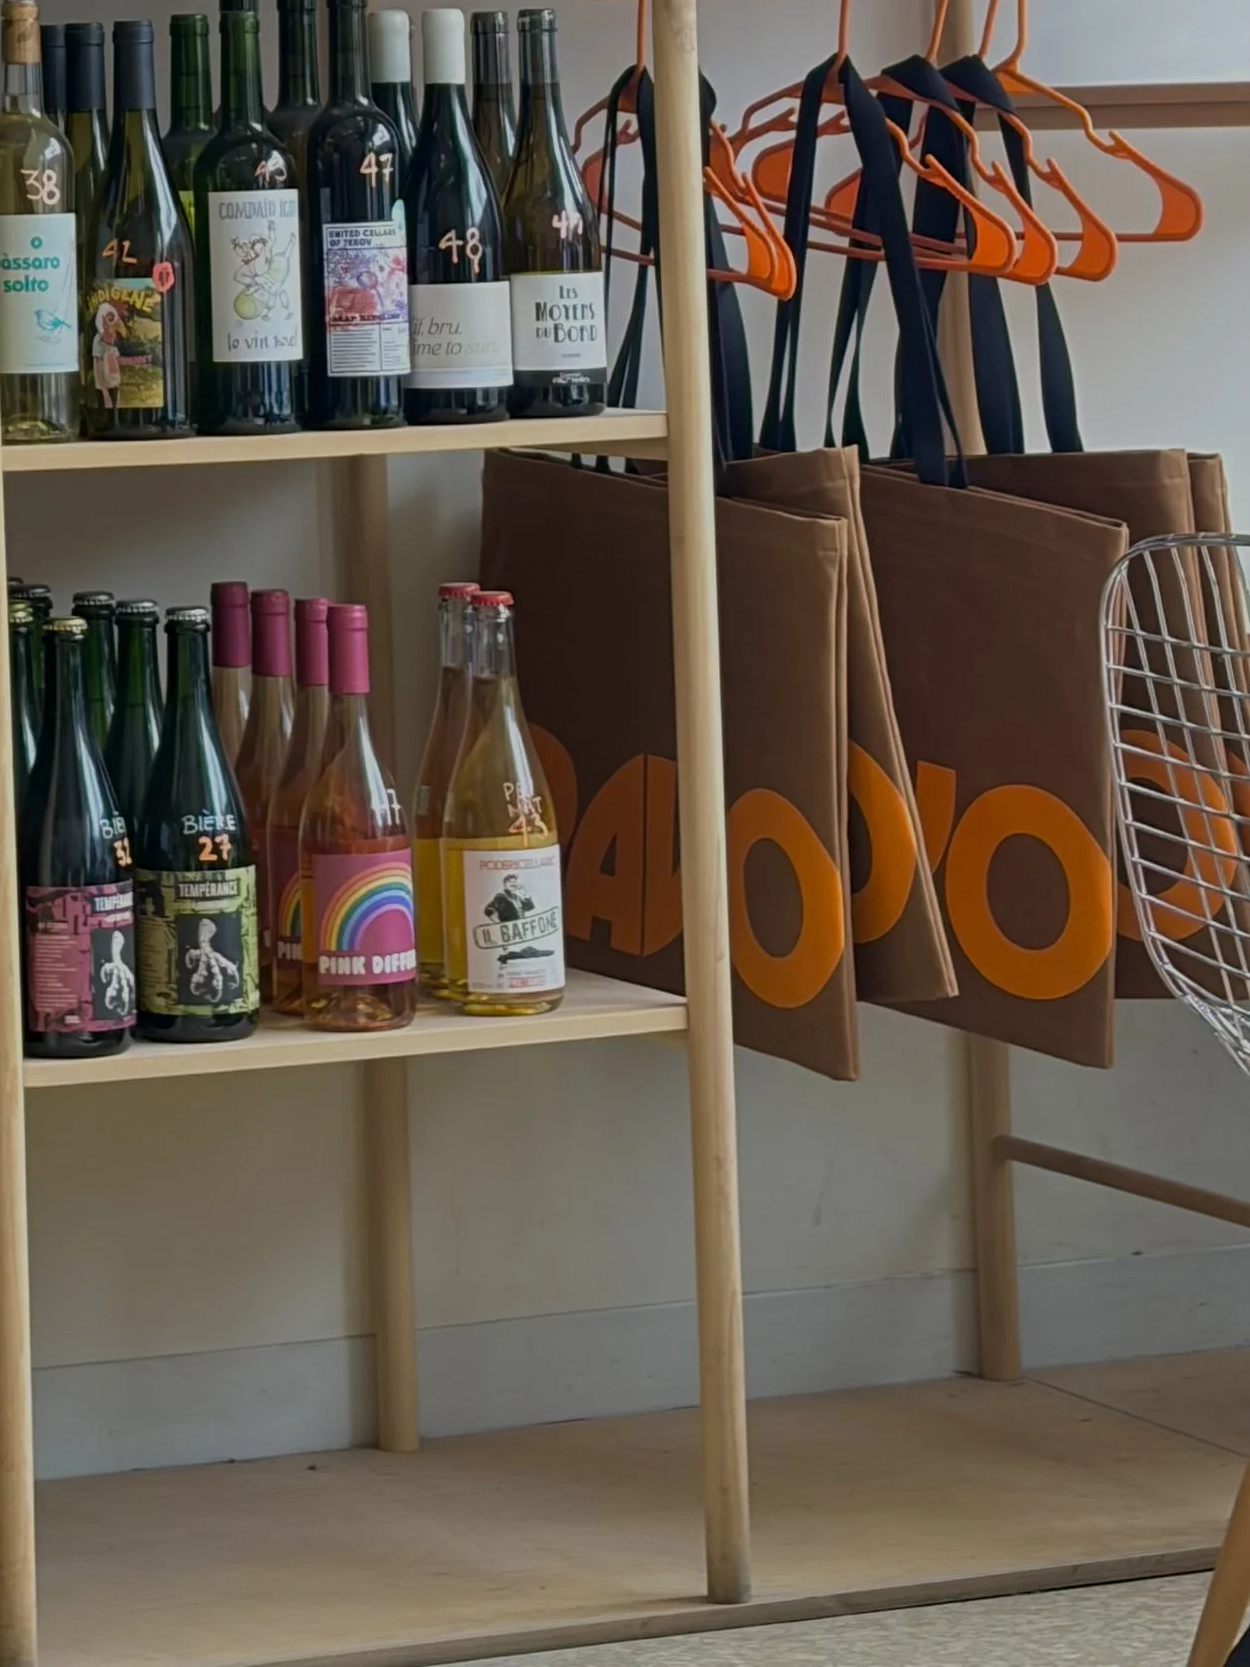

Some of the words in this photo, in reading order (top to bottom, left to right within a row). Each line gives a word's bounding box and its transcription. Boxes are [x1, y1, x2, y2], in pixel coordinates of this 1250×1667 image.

[359, 153, 394, 190] 47
[20, 169, 60, 205] 38
[2, 274, 49, 293] solto
[244, 330, 269, 349] vin
[412, 338, 442, 356] ime
[446, 340, 463, 356] to
[182, 810, 237, 835] BIÈRE
[507, 813, 548, 847] 43
[198, 833, 232, 862] 27
[481, 926, 493, 944] IL
[500, 912, 558, 943] BAFFONE
[277, 940, 302, 961] PIN
[318, 955, 366, 975] PINK
